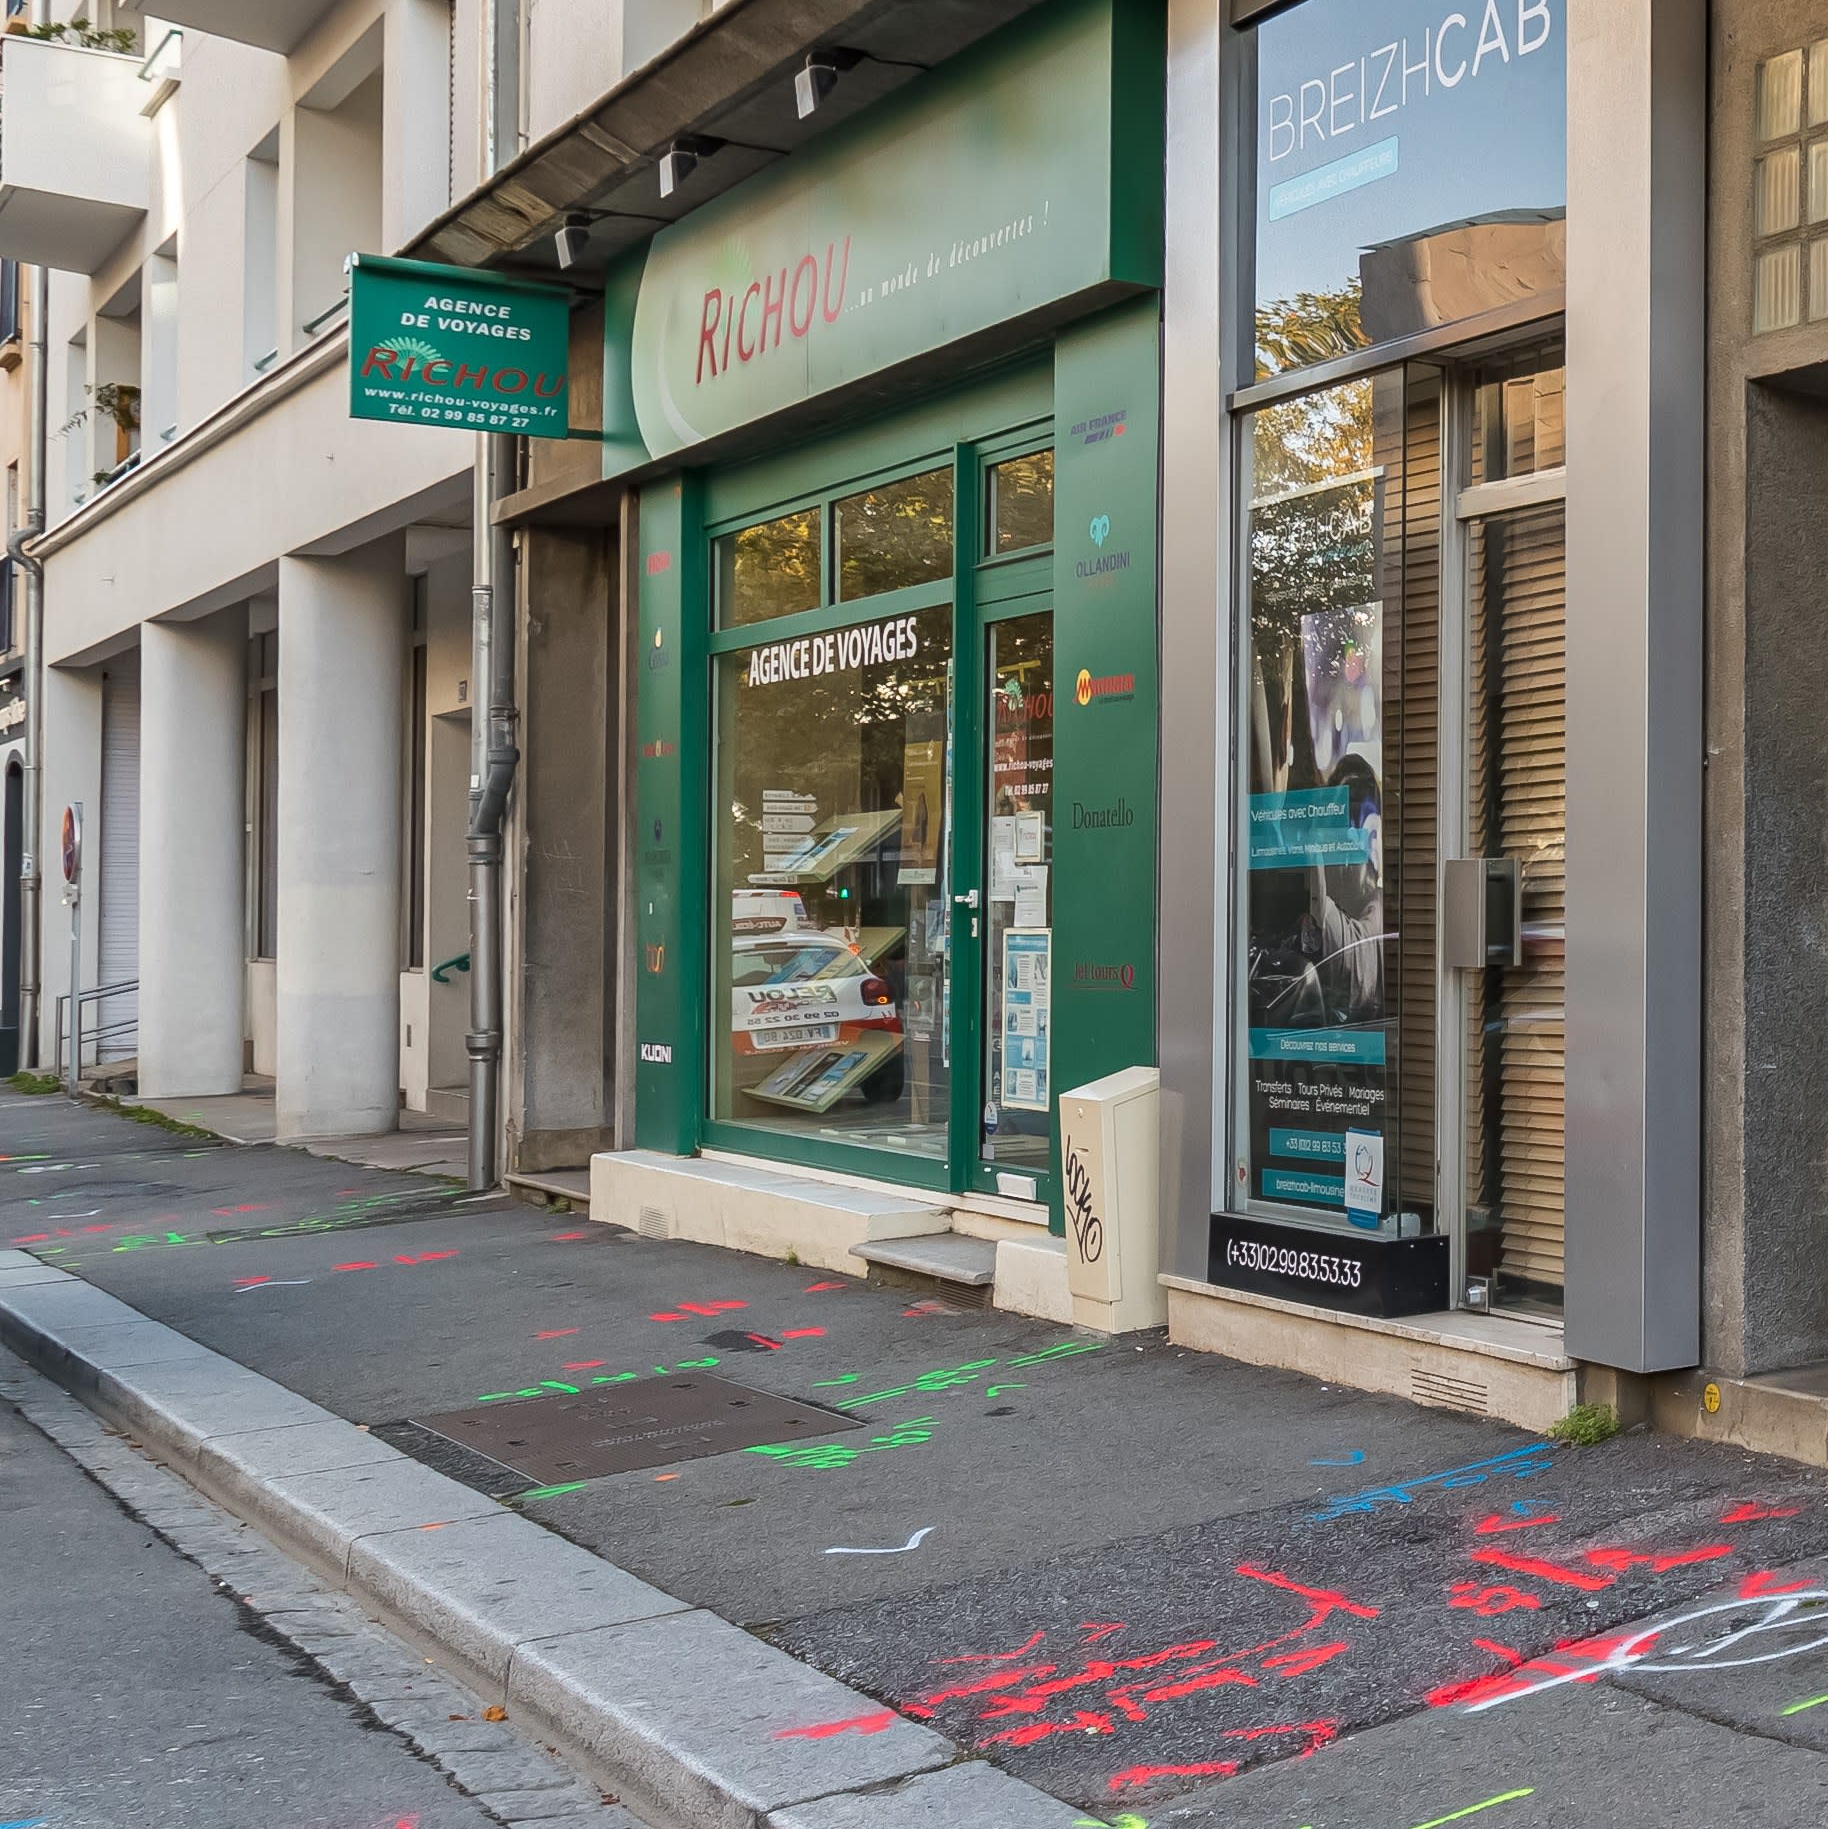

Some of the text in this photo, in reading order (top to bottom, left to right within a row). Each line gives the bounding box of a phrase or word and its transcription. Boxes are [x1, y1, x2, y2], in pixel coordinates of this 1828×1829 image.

[424, 296, 512, 319] AGENCE
[695, 235, 852, 388] RICHOU
[881, 262, 918, 298] monde
[927, 252, 941, 278] de
[949, 213, 1033, 269] découvertes
[400, 312, 531, 341] DE VOYAGES
[360, 347, 566, 398] RICHOU
[364, 387, 558, 417] www.richou-voyages.fr
[388, 403, 530, 428] Tél. 02 99 85 87 27
[1070, 410, 1127, 436] AIR FRANCE
[1075, 551, 1131, 578] OLLANDINI
[748, 616, 918, 688] AGENCE DE VOYAGES
[1072, 798, 1134, 830] Donatello
[1288, 807, 1306, 819] avec
[1308, 802, 1346, 816] Chauffeur
[640, 1043, 672, 1063] KUONI
[1280, 1039, 1313, 1051] Découvrez
[1314, 1042, 1328, 1052] nos
[1255, 1079, 1385, 1104] Transferts Tours Privés Mariages
[1268, 1096, 1310, 1111] Séminaires
[1227, 1238, 1361, 1287] (+33)02.99.83.53.33
